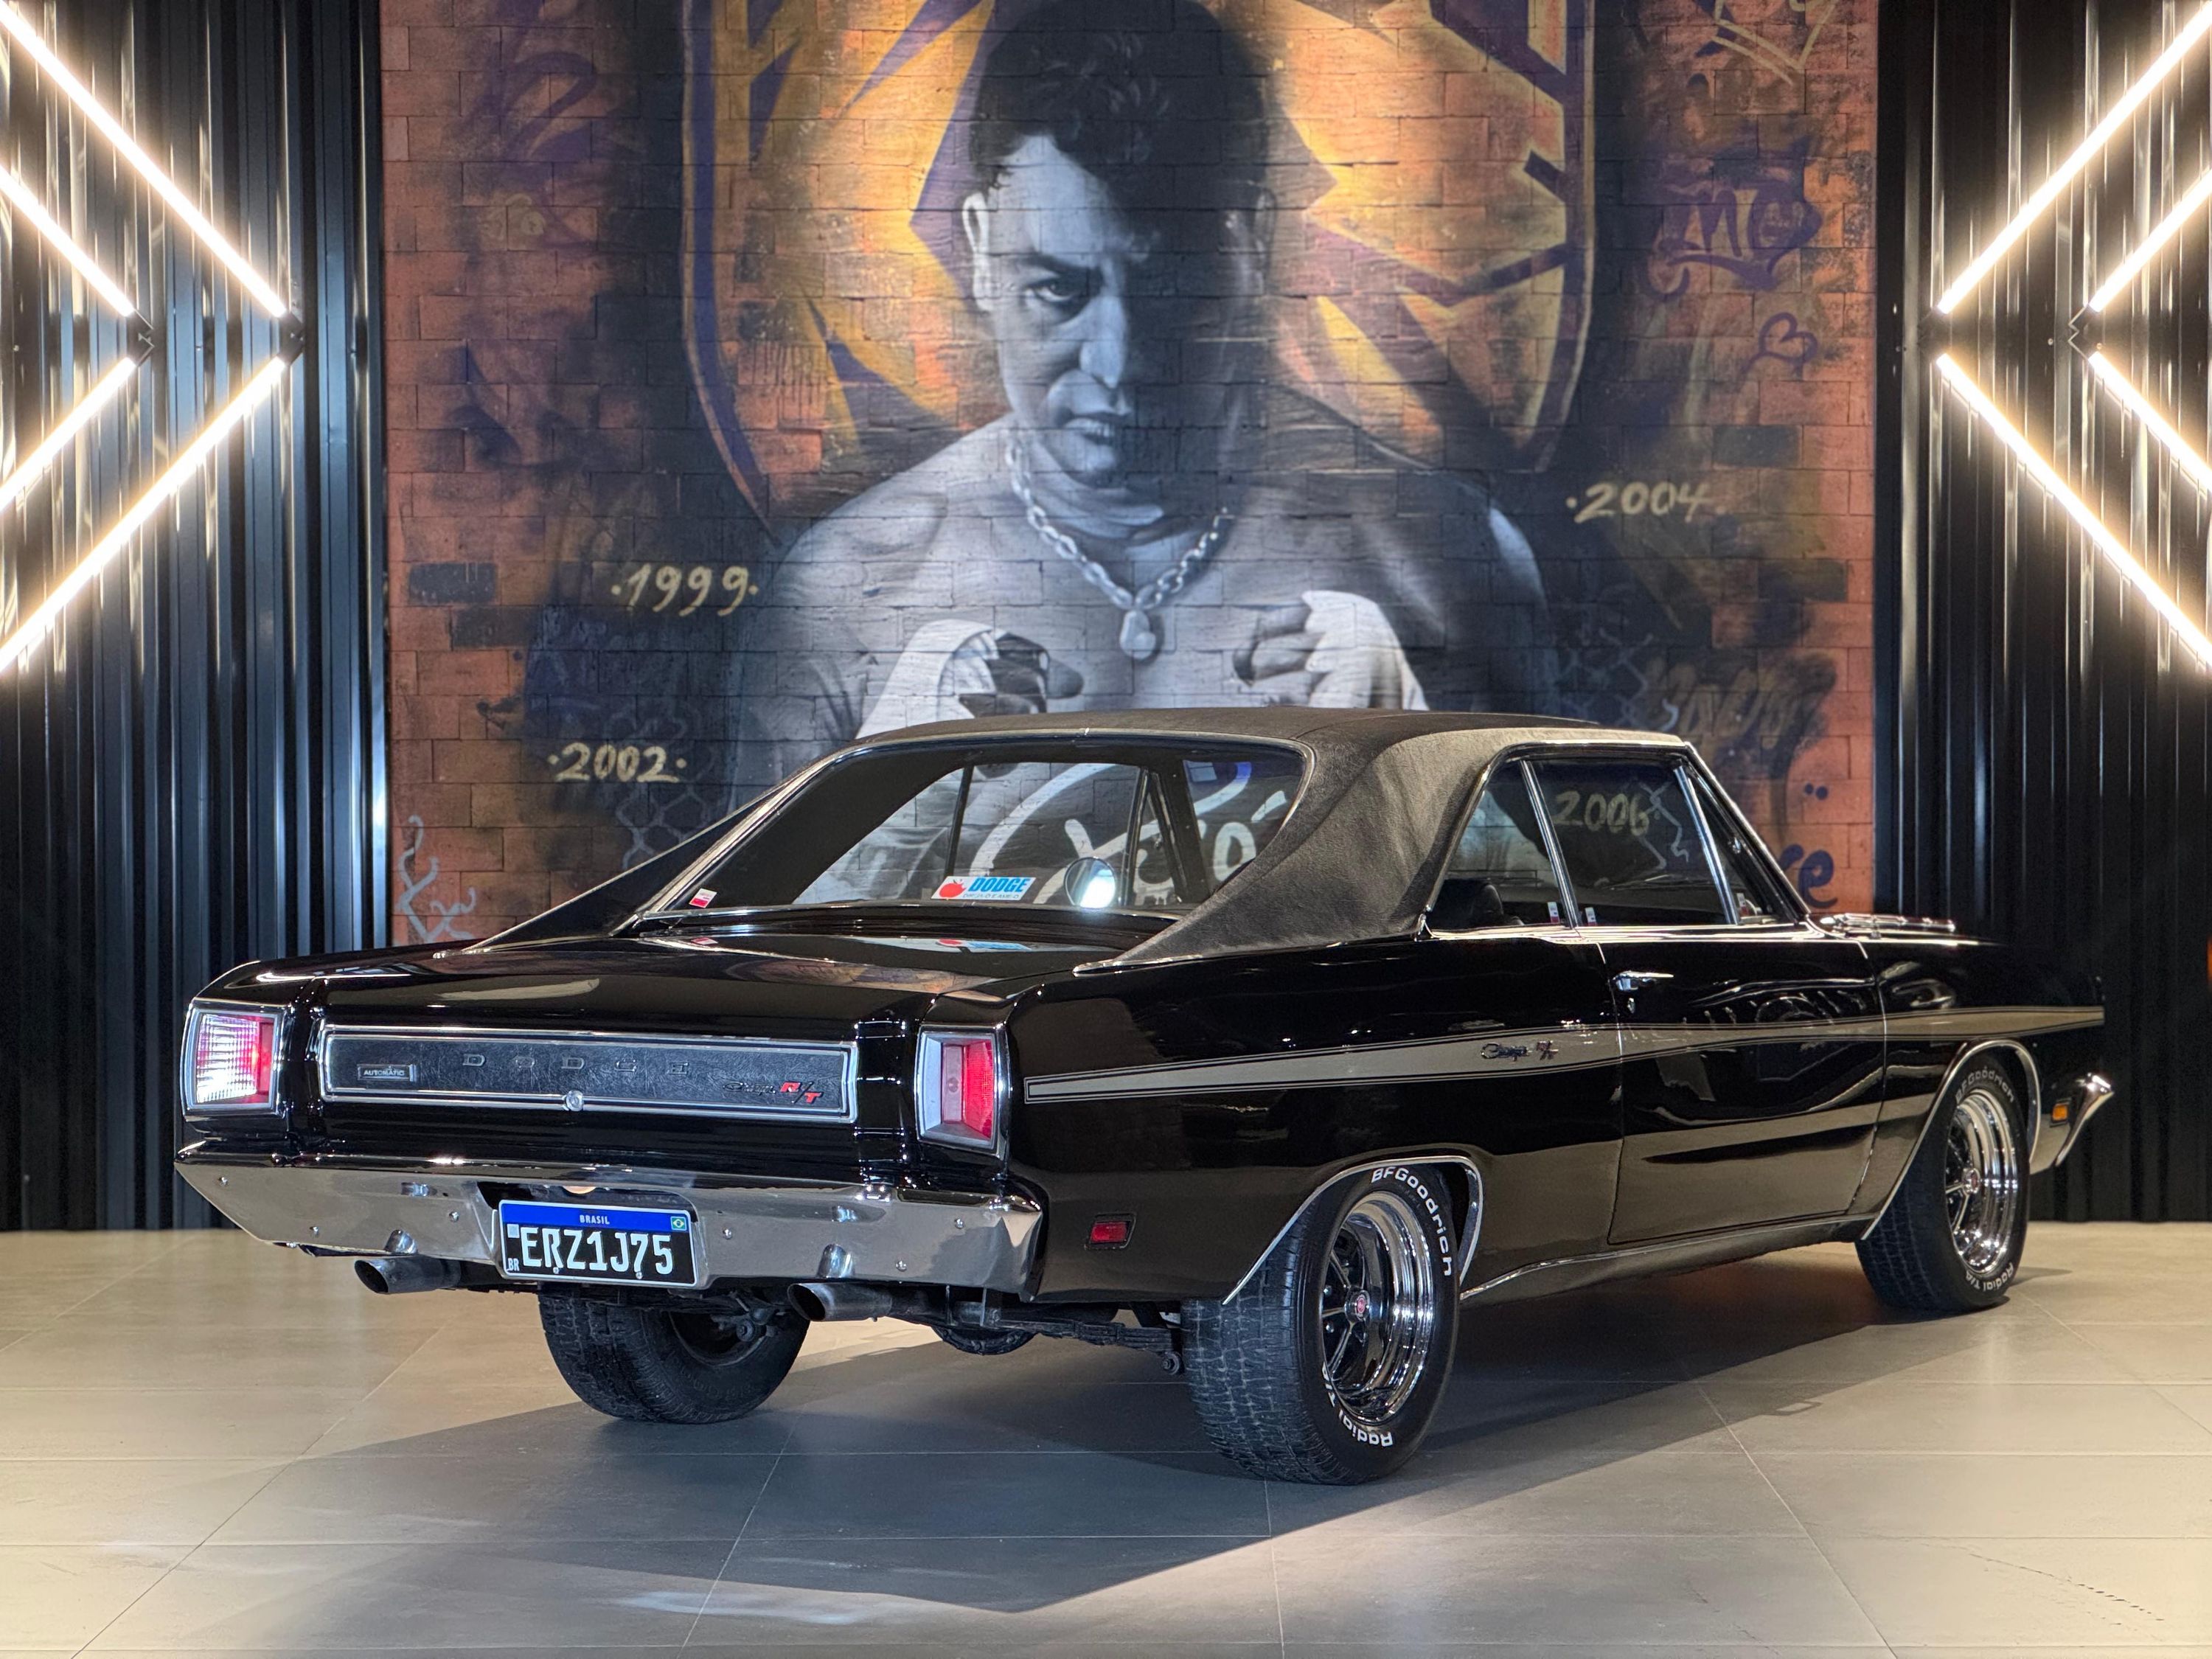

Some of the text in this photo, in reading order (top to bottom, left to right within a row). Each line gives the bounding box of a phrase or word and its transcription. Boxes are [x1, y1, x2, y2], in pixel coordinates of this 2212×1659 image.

[969, 877, 1031, 892] DODGE
[779, 1081, 824, 1104] R/T
[579, 1214, 611, 1225] BRASIL
[1371, 1166, 1452, 1276] BFGoodrich
[520, 1226, 674, 1275] ERZ1J75
[507, 1257, 520, 1272] BR
[1339, 1409, 1394, 1447] Radial
